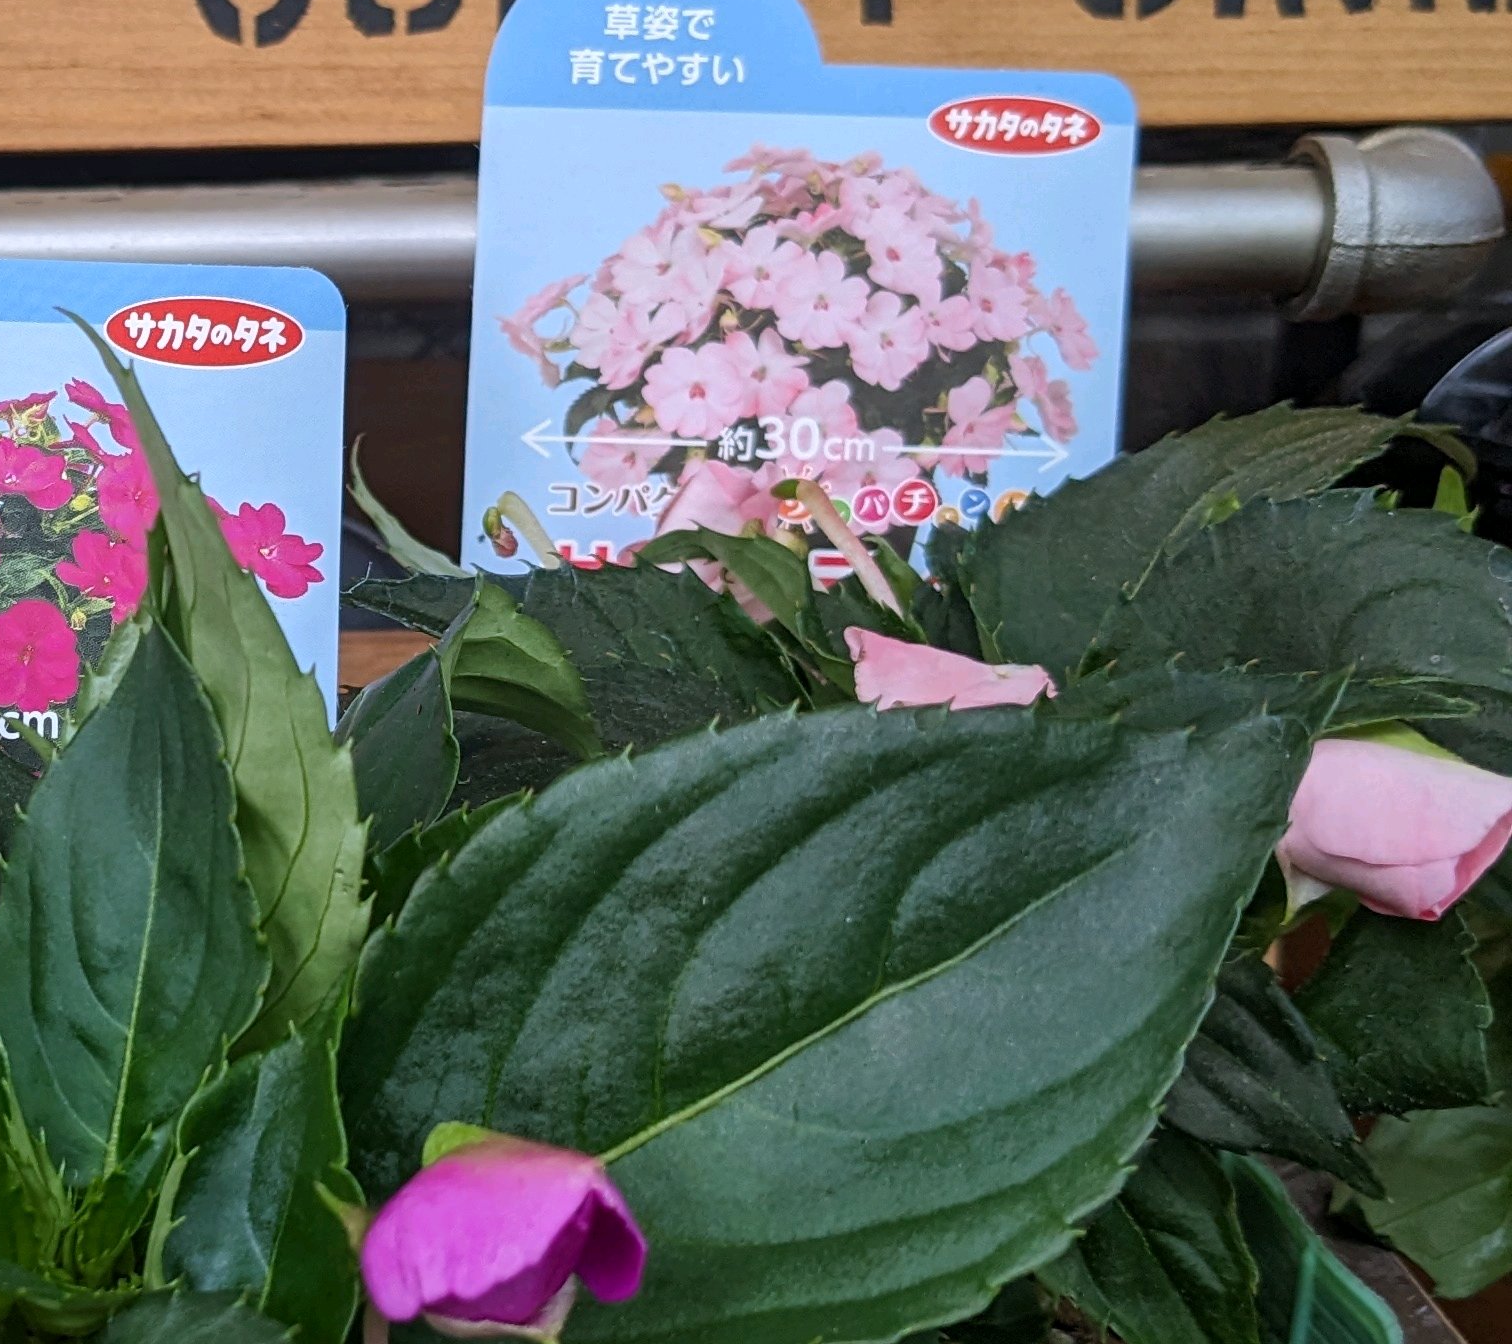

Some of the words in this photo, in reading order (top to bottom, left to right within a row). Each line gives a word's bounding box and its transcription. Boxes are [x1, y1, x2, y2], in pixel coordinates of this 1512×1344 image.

[603, 4, 715, 41] 草姿で
[569, 48, 744, 86] 育てやすい
[944, 107, 1087, 145] サカタのタネ
[124, 312, 288, 357] サカタのタネ
[717, 416, 876, 462] 約30cm
